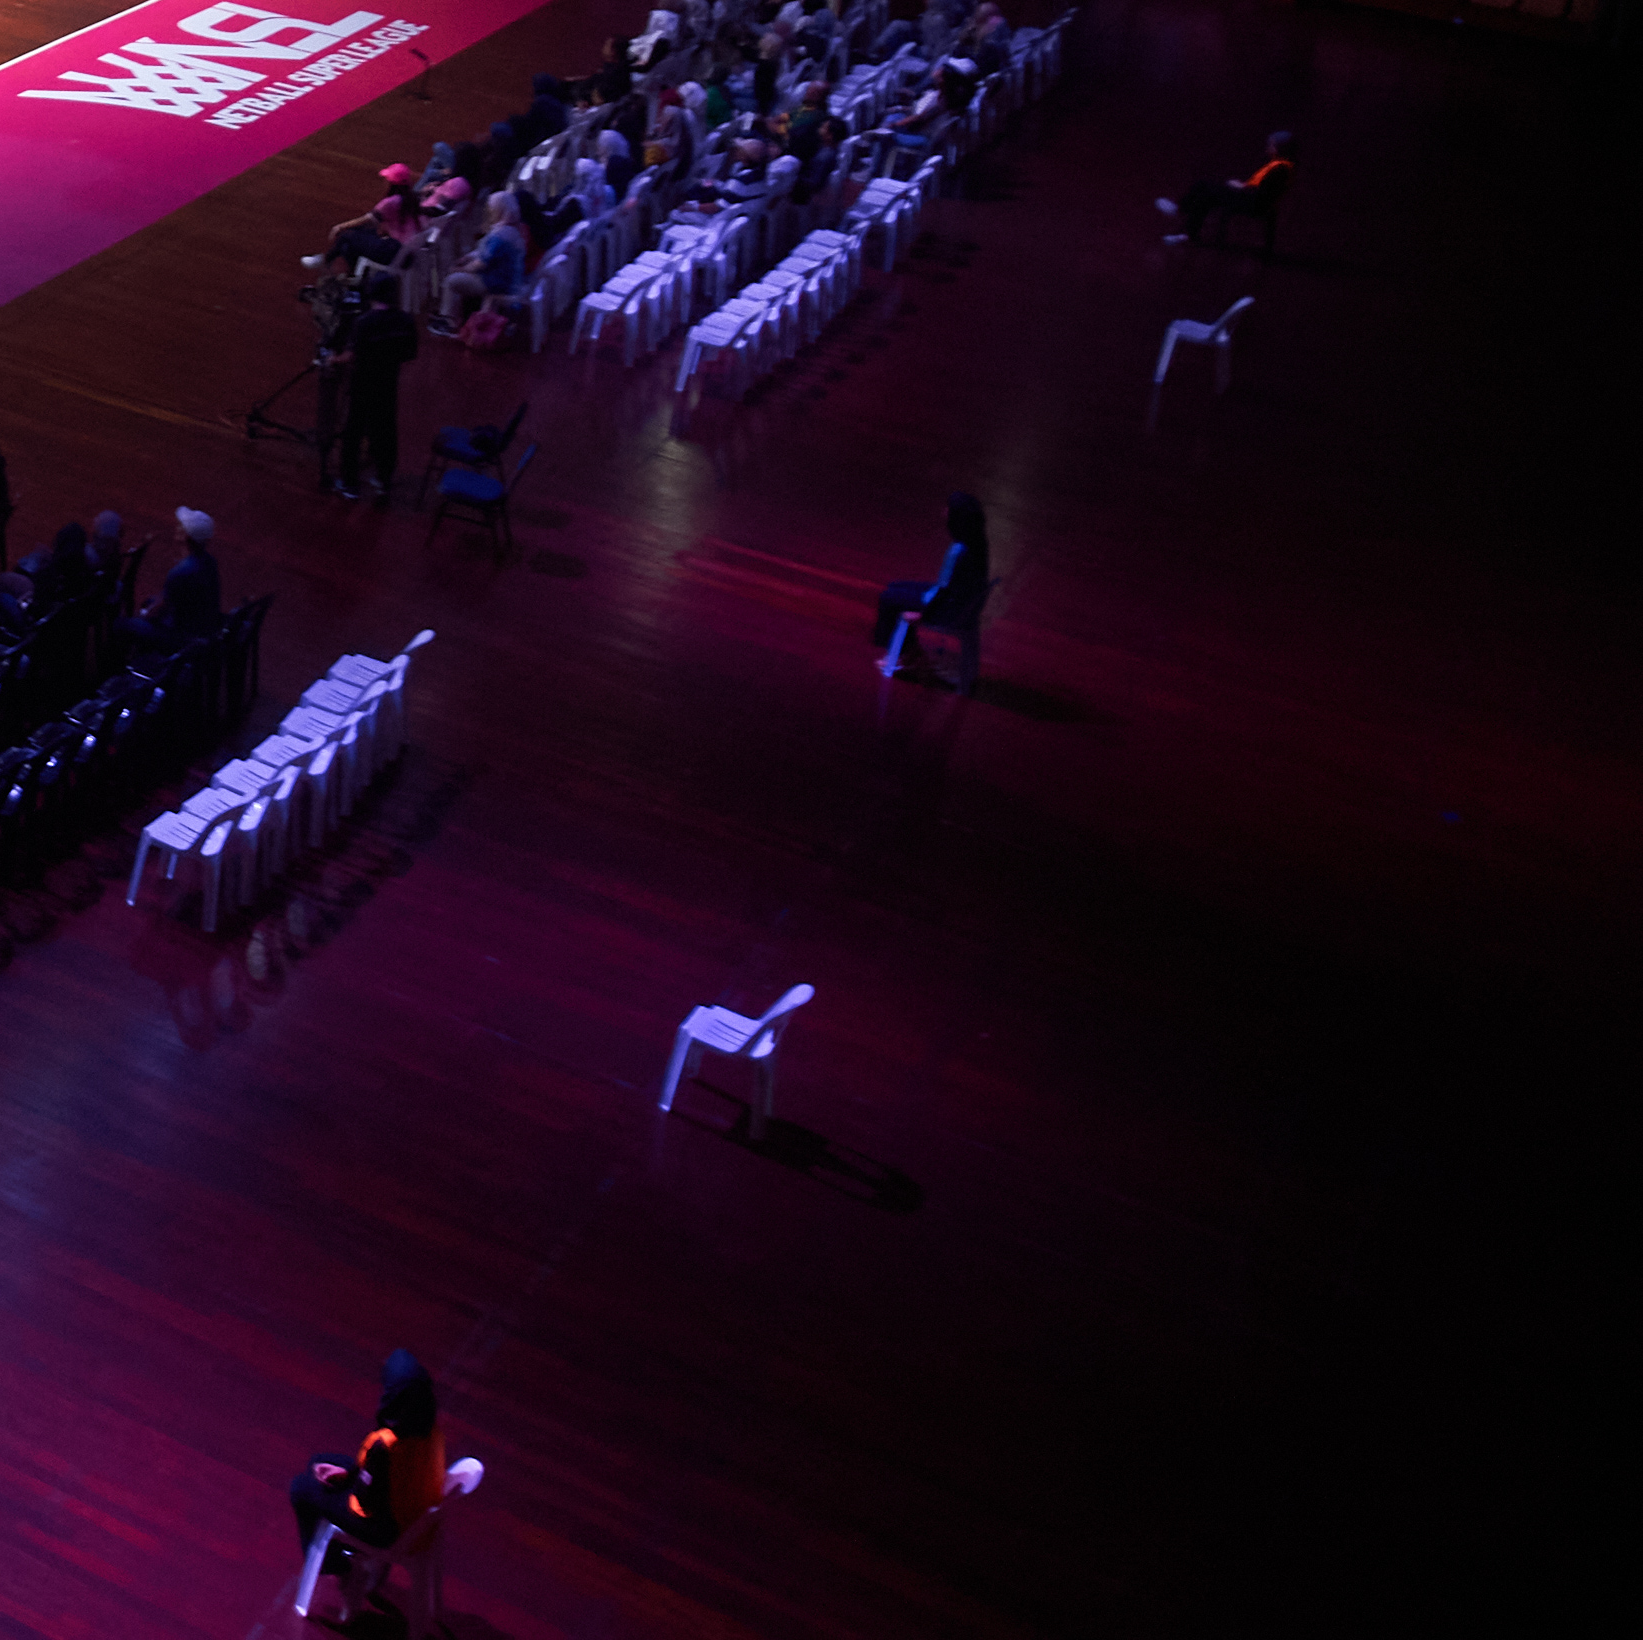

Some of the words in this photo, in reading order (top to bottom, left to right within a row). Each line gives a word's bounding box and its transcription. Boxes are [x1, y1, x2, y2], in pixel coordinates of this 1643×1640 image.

[203, 81, 316, 130] NETBALL
[287, 48, 367, 87] SUPER
[347, 19, 431, 61] LEAGUE
